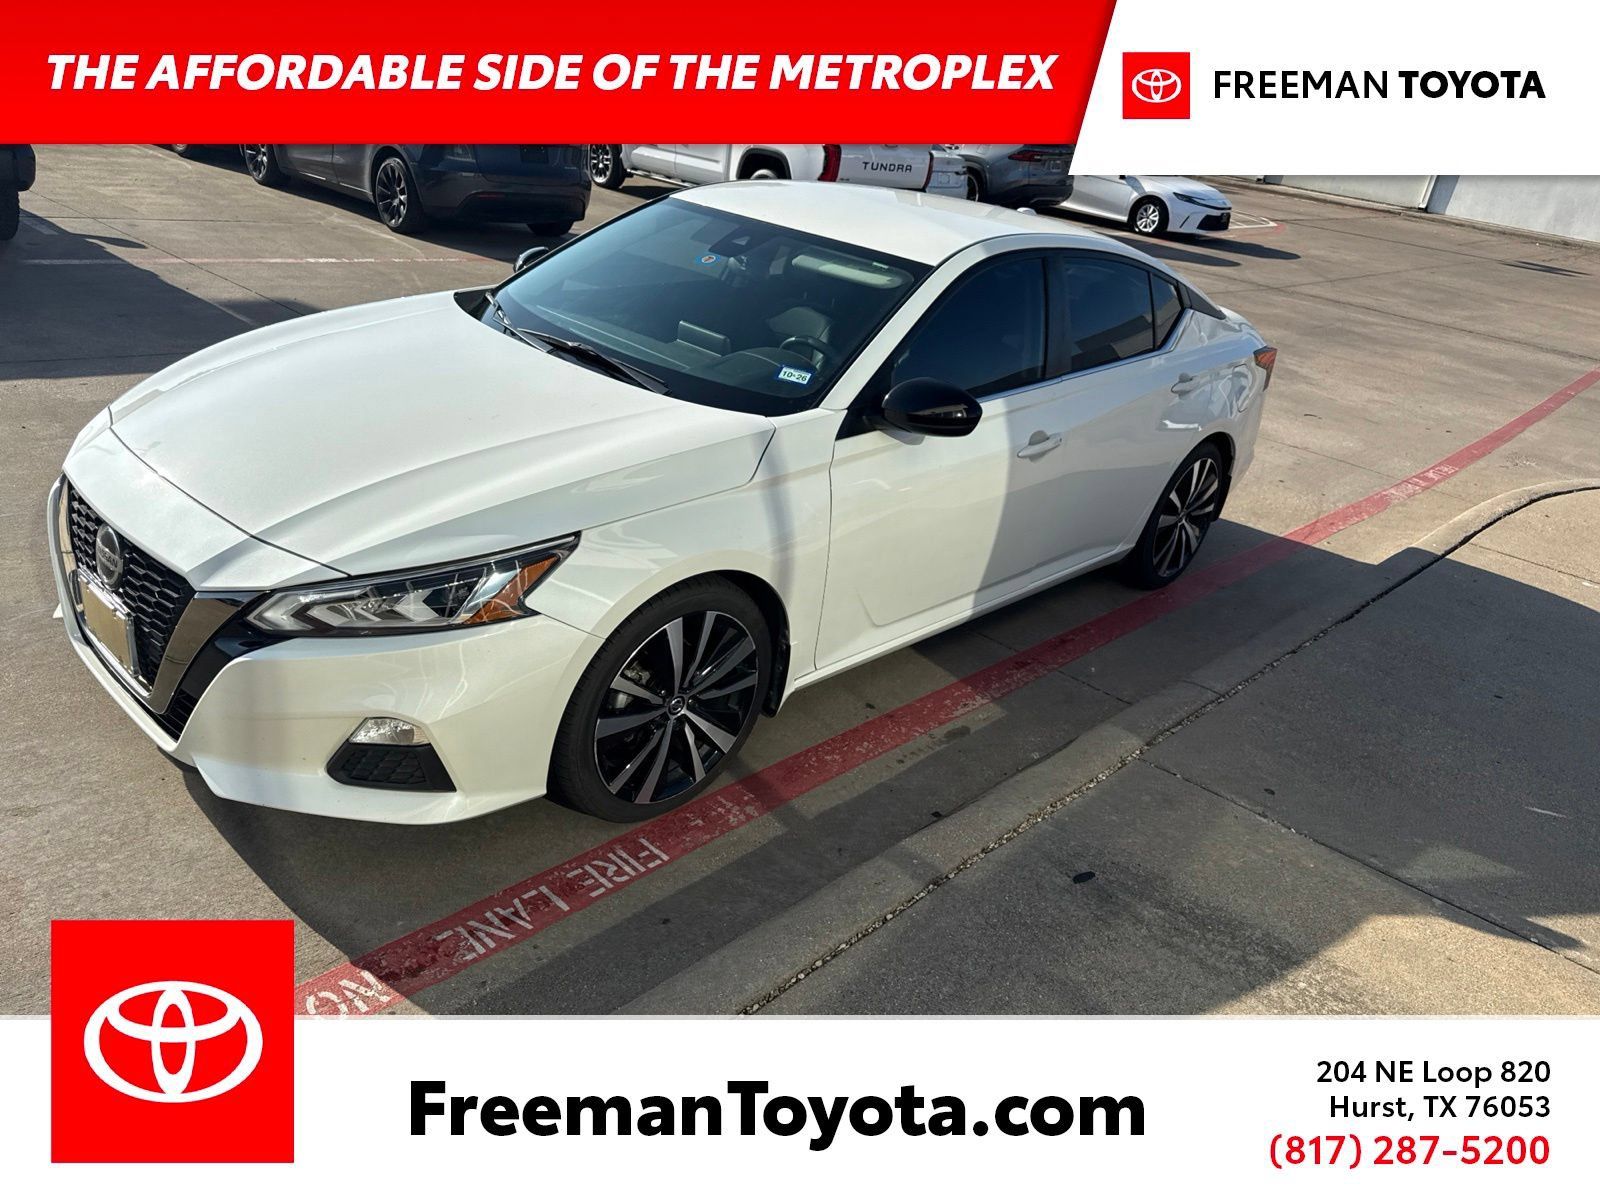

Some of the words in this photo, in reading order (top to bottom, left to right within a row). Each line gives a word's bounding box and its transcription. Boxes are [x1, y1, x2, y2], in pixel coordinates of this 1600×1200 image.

[862, 161, 912, 173] TUNDRA
[566, 837, 670, 898] FIRE
[434, 885, 570, 961] LANE
